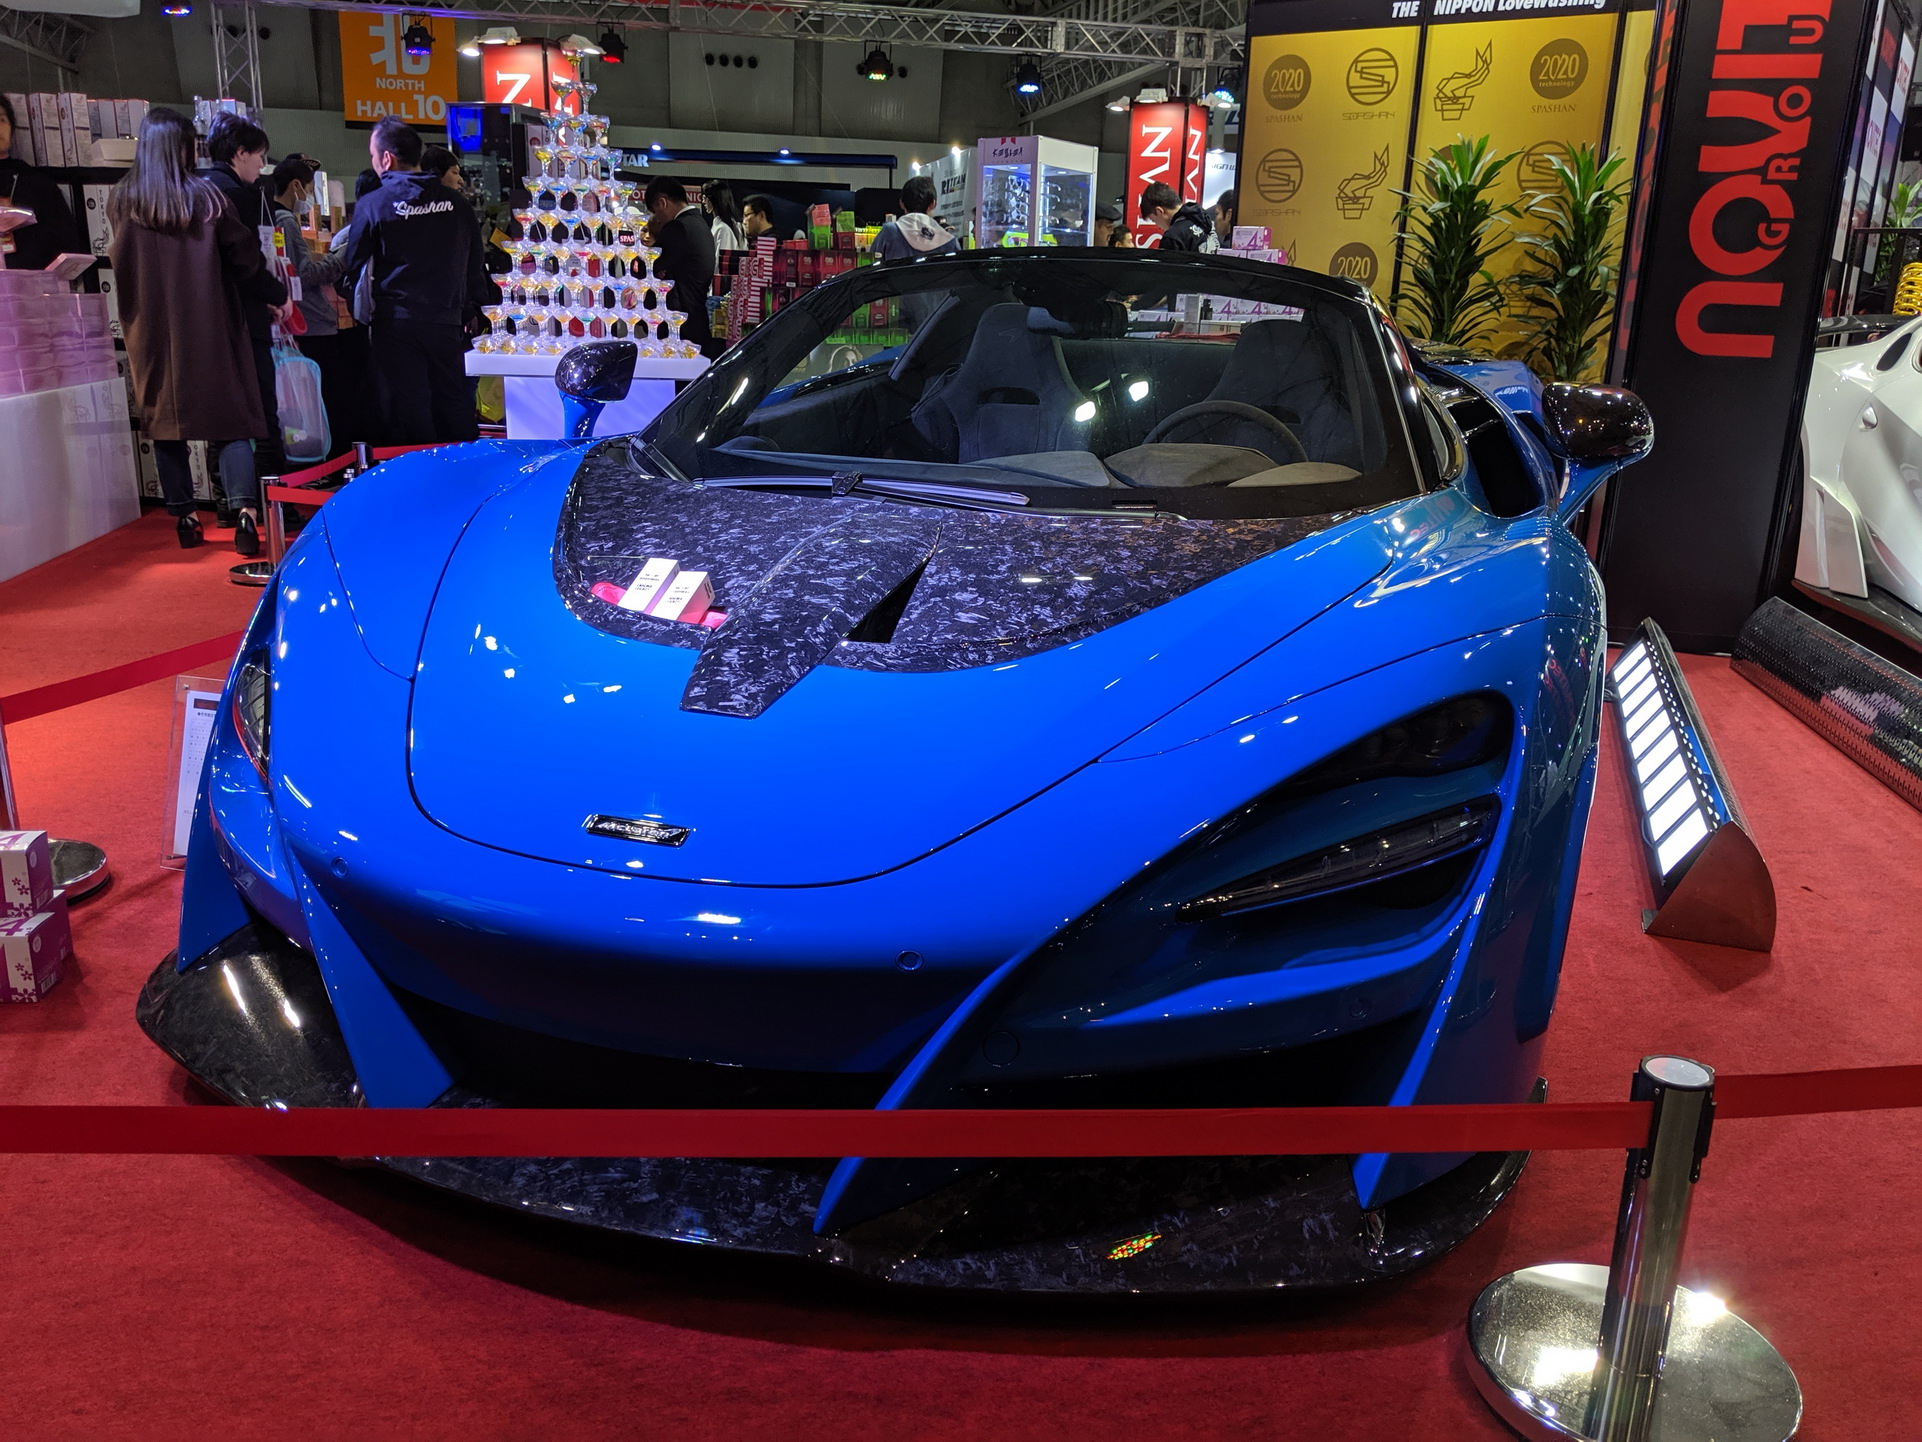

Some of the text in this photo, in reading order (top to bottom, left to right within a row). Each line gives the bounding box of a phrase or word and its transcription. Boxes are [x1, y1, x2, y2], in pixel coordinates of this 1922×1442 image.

[1392, 1, 1420, 18] THE
[1433, 0, 1494, 15] NIPPON
[1538, 53, 1580, 81] 2020
[376, 77, 425, 91] NORTH
[1270, 68, 1304, 92] 2020
[356, 93, 447, 121] HALL 10
[1531, 103, 1577, 113] SPASHAN
[622, 153, 649, 168] TAR
[395, 200, 454, 220] Spashan
[1337, 255, 1371, 280] 2020
